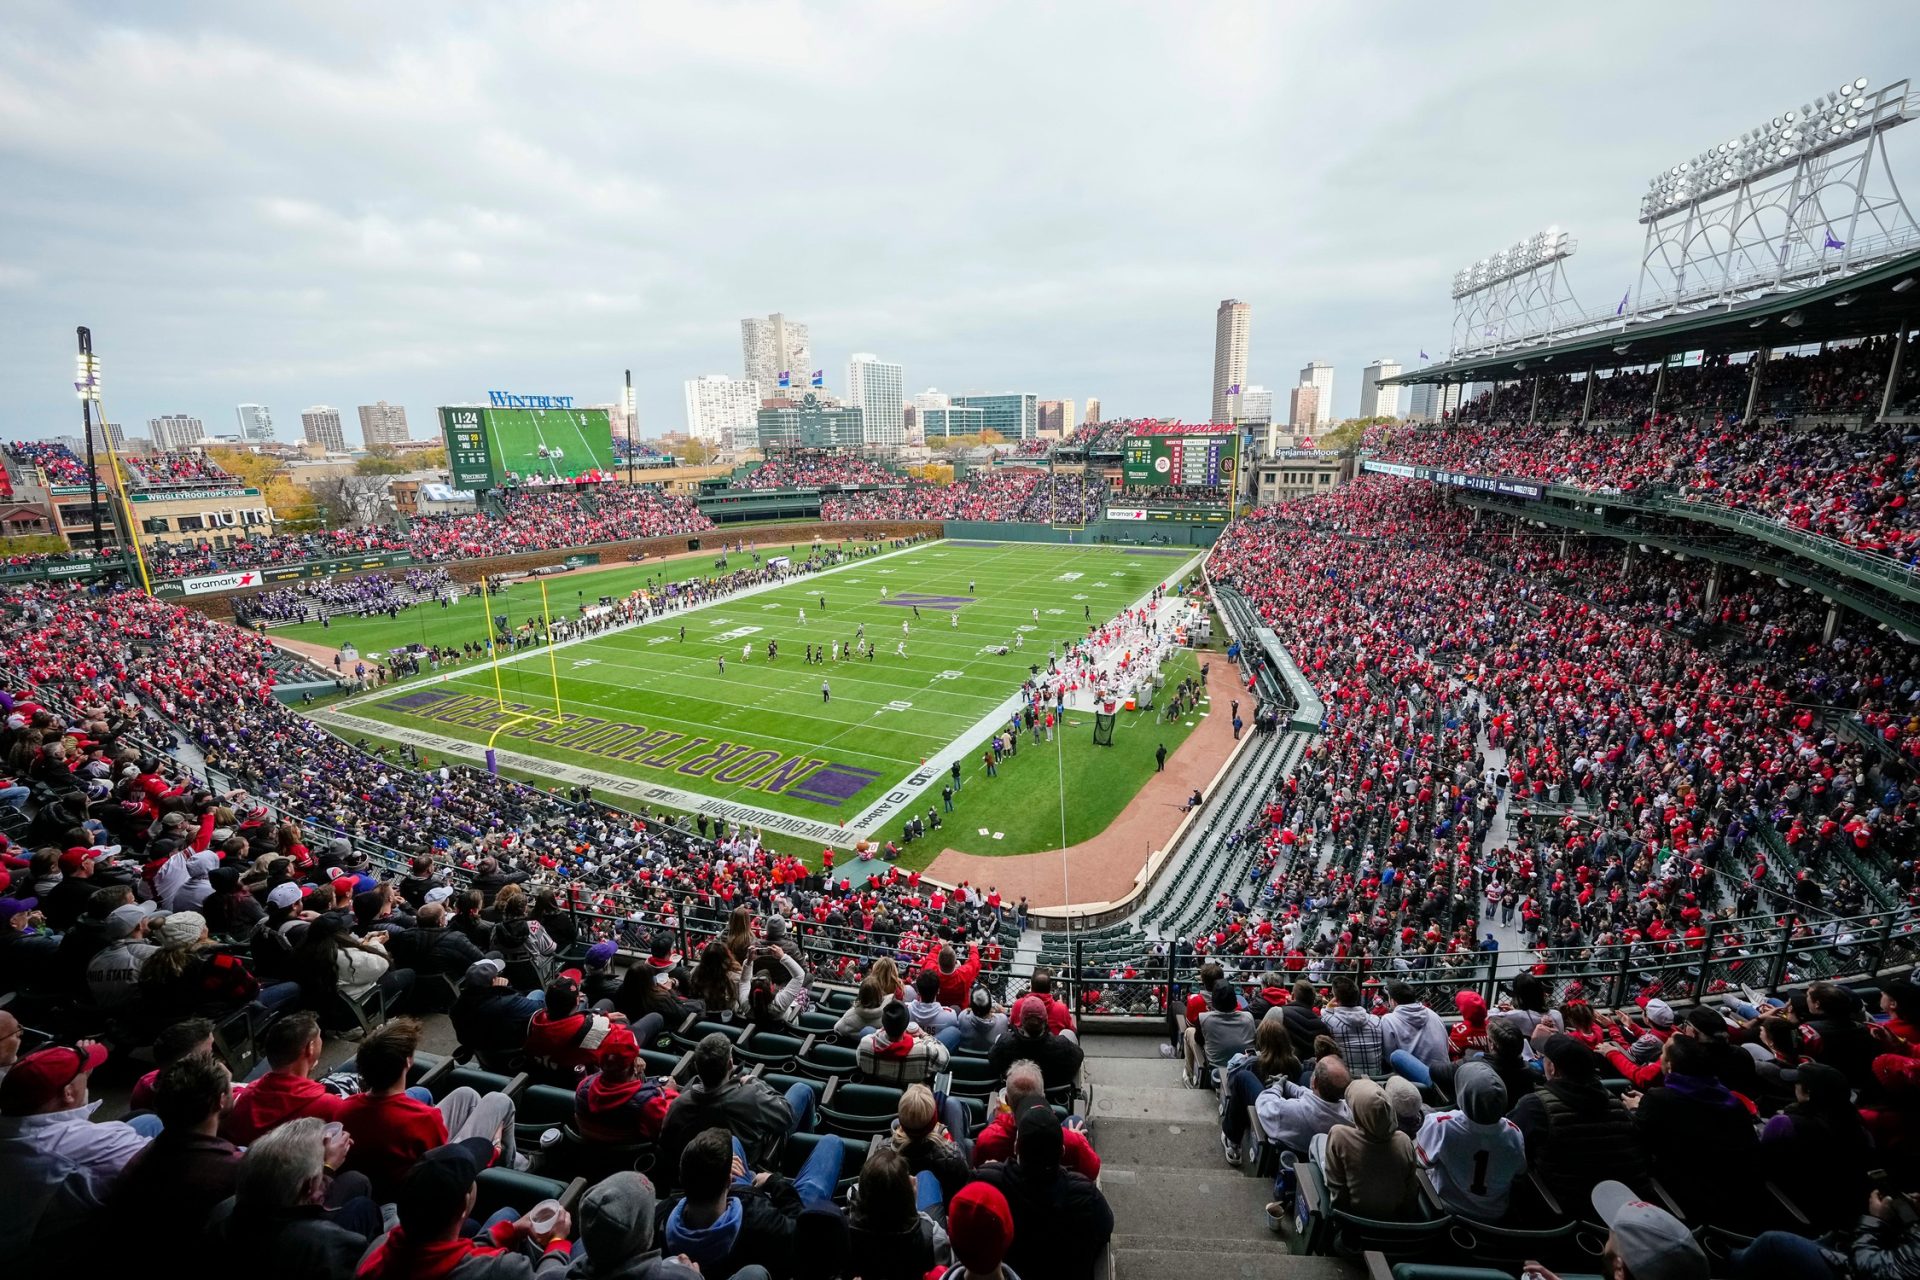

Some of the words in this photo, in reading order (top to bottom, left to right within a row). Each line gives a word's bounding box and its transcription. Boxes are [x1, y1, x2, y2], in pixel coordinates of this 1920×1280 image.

[488, 390, 573, 409] WINTRUST
[452, 412, 478, 424] 11:24
[1275, 449, 1311, 457] Benjamin
[147, 489, 246, 501] WRIGLEYROOFTOPS.COM
[47, 563, 92, 573] GRAINGER
[189, 576, 238, 591] aramark
[404, 693, 829, 795] NORTHWESTERN
[693, 799, 736, 819] DRIVE
[733, 808, 777, 826] BLOOD
[854, 802, 892, 829] Abbott
[774, 817, 806, 834] GIVE
[802, 824, 829, 840] WE
[824, 828, 855, 845] THE
[1470, 1150, 1490, 1196] 1
